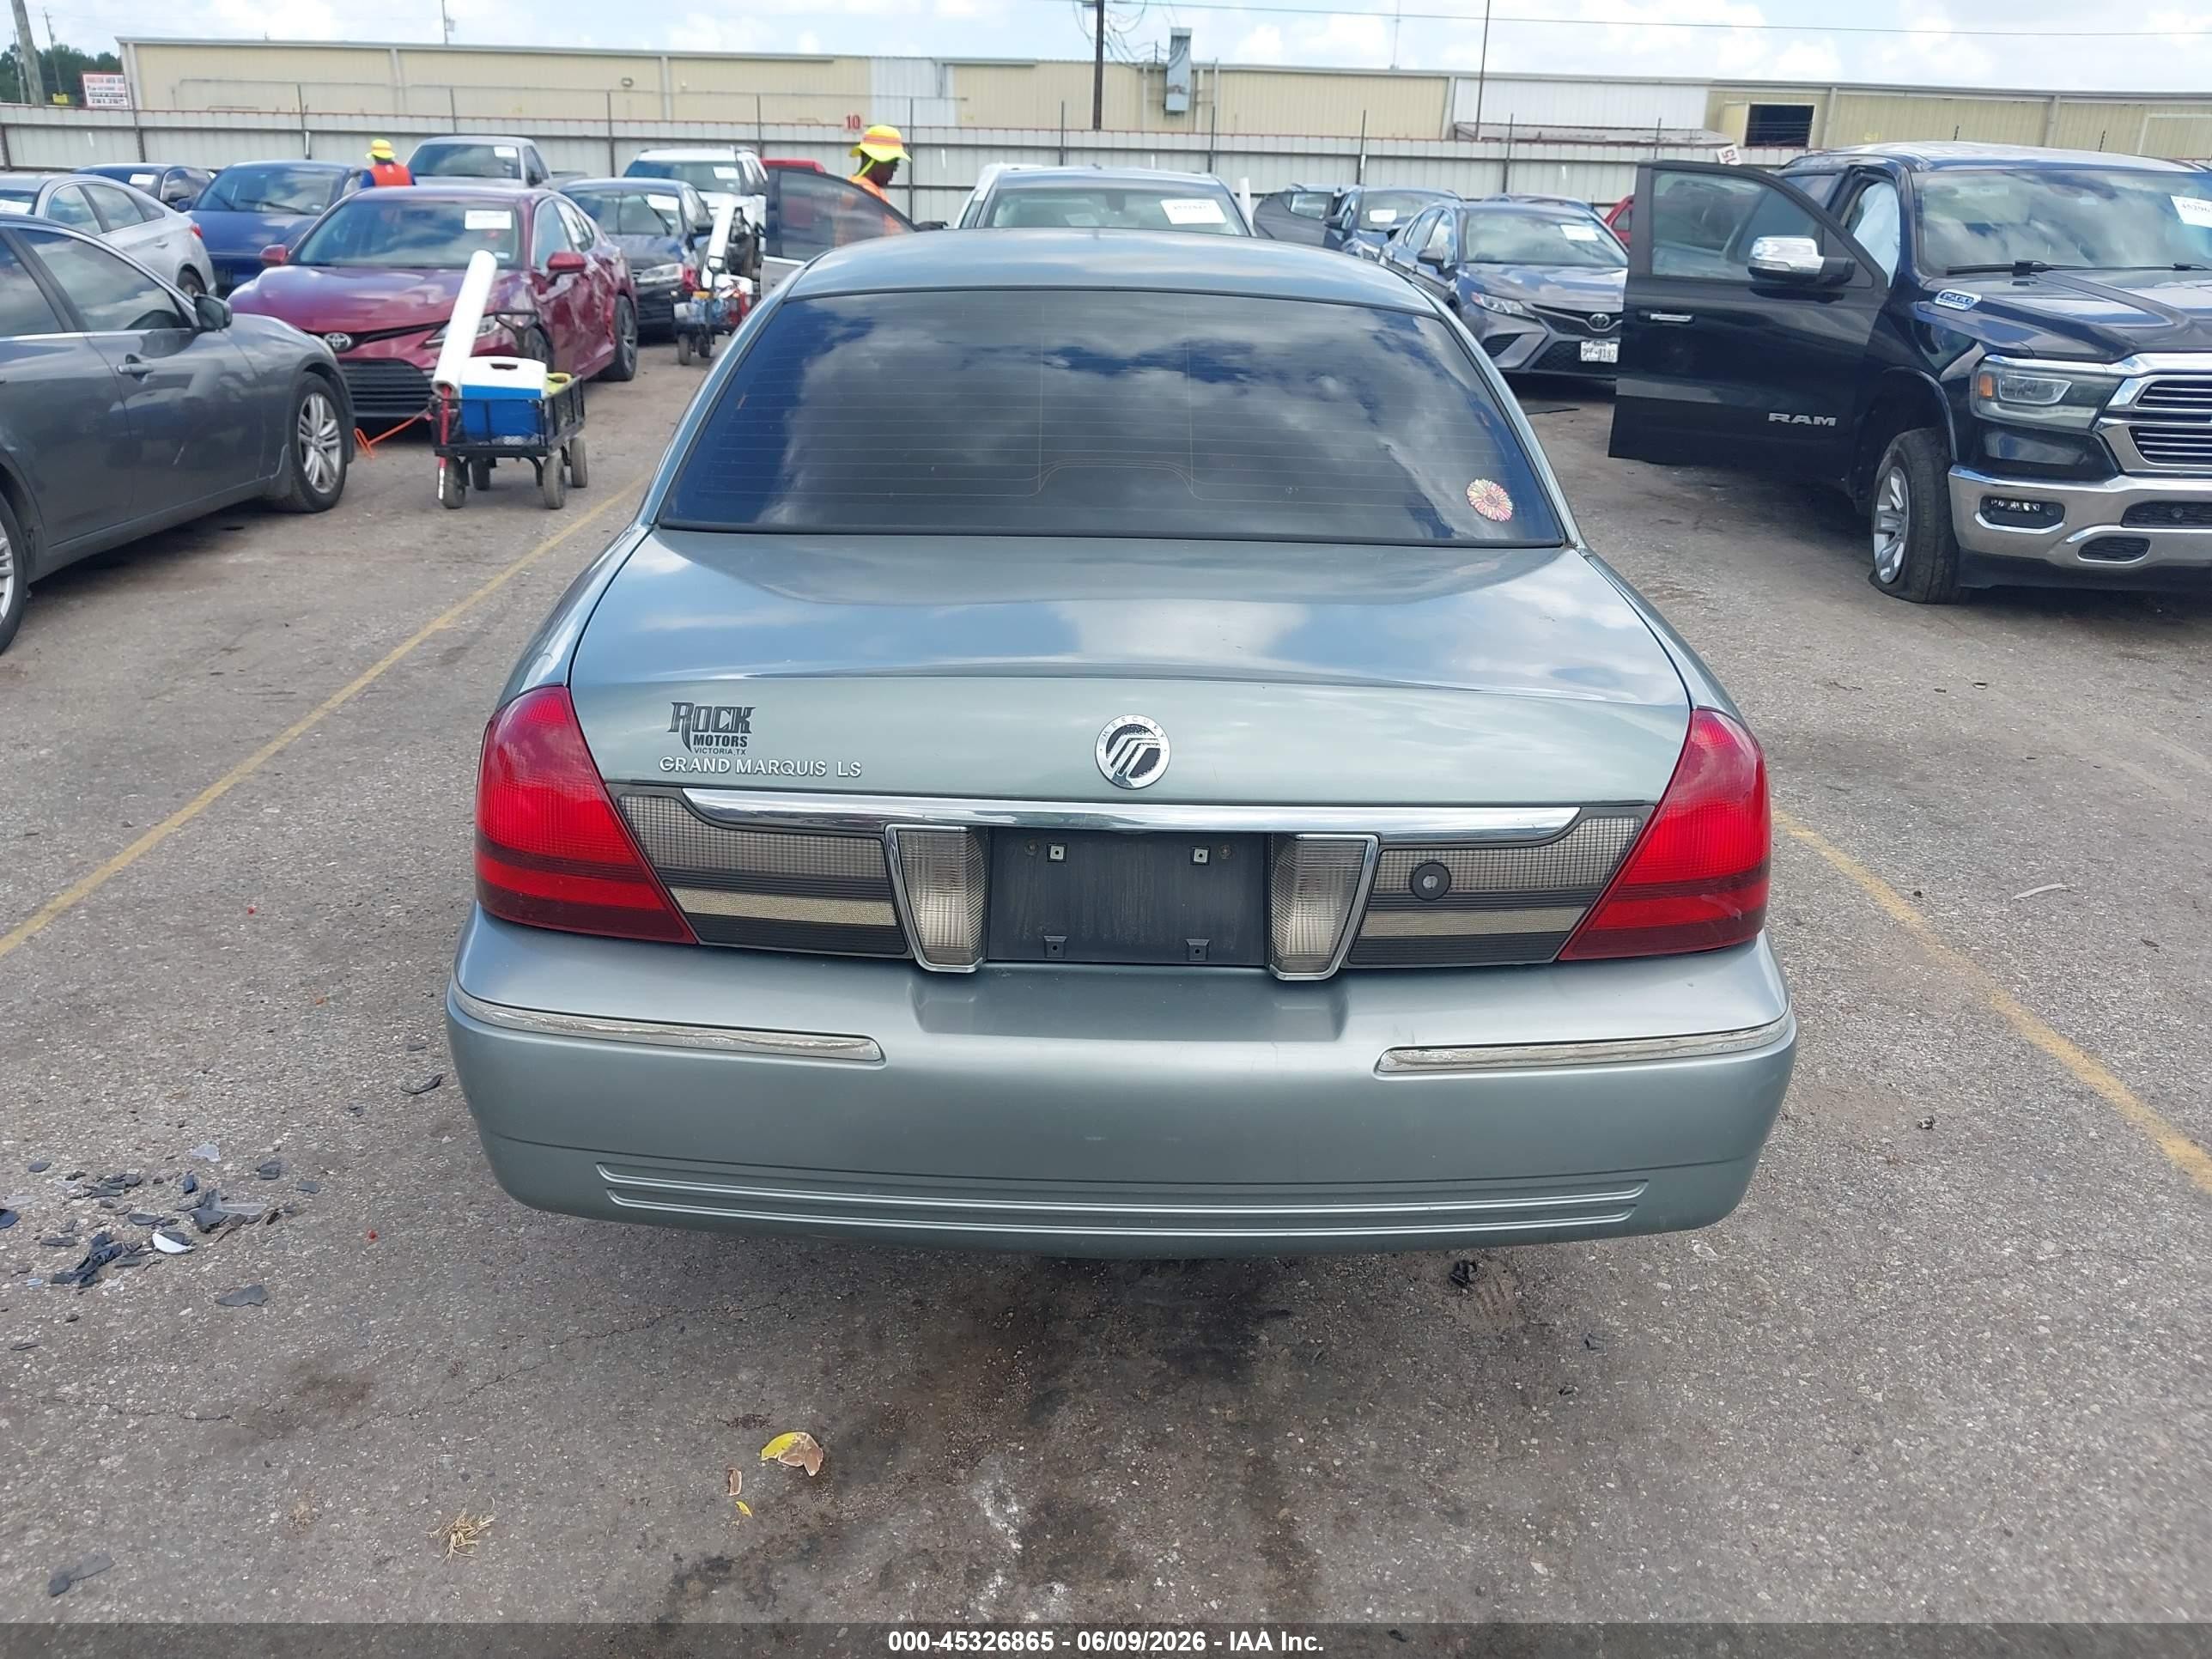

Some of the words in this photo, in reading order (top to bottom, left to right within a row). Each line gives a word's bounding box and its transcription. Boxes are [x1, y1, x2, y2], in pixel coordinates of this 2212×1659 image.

[846, 114, 860, 130] 10
[1768, 412, 1837, 426] RAM
[666, 702, 757, 753] ROCK
[693, 734, 748, 748] MOTORS
[659, 756, 731, 774] GRAND
[735, 759, 827, 778] MARQUIS
[836, 760, 862, 777] LS
